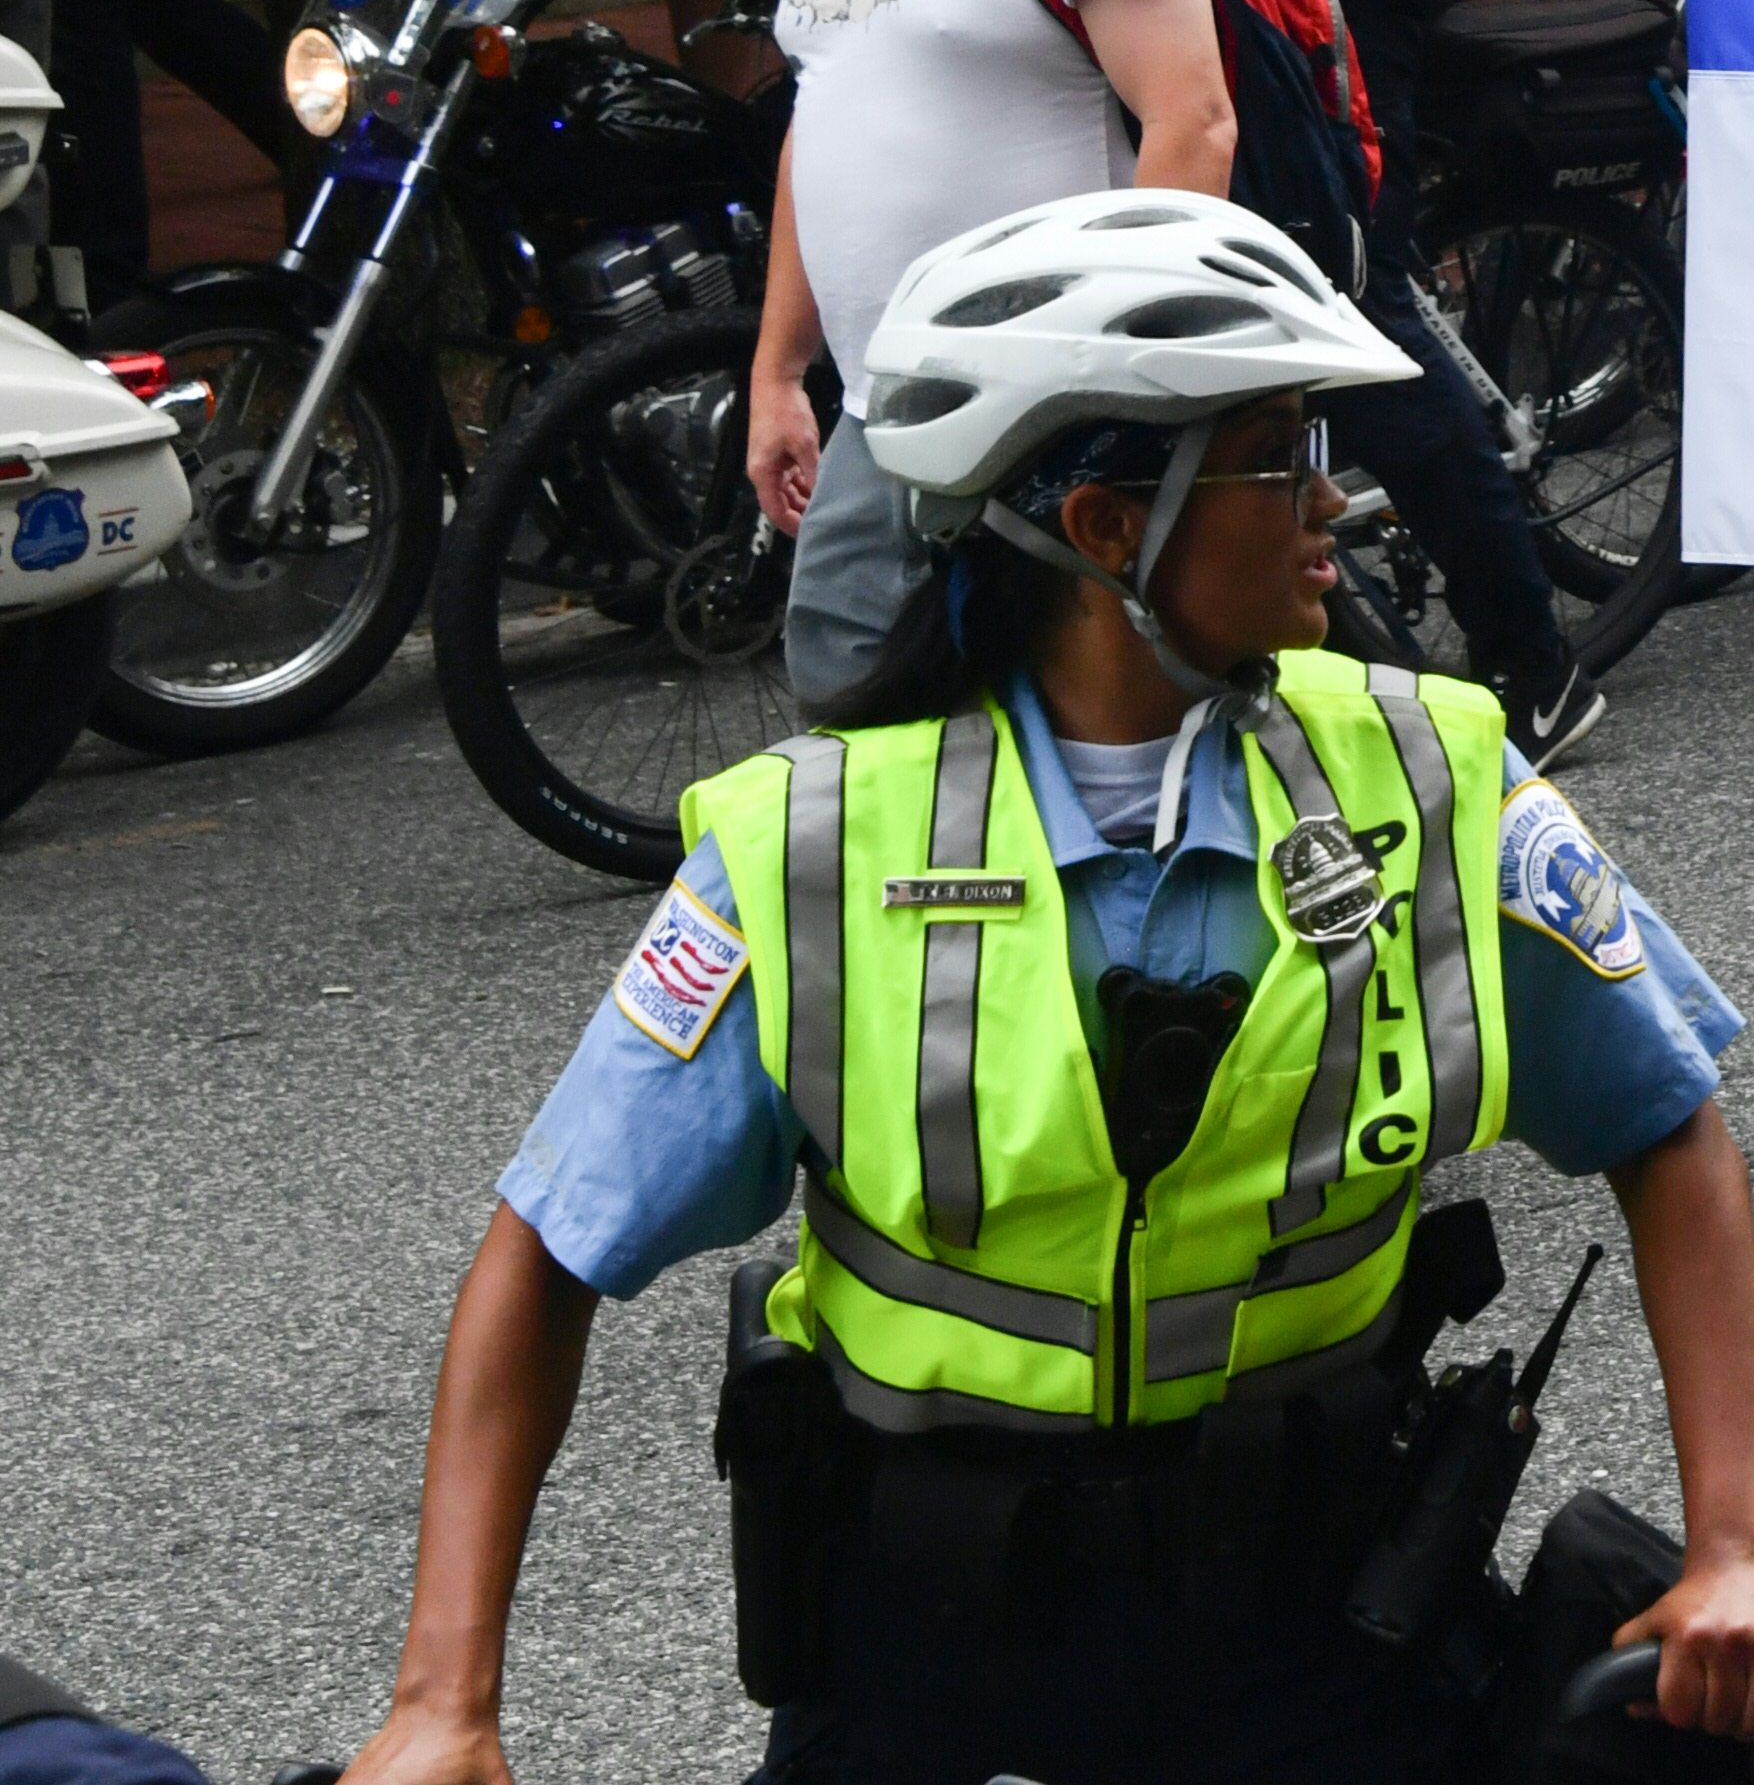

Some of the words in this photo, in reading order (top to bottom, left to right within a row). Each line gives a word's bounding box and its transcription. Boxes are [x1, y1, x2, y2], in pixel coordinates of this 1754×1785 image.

[598, 108, 709, 134] Rebel
[1553, 162, 1644, 190] POLICE
[102, 517, 136, 547] DC
[963, 884, 1014, 901] DIXON
[668, 897, 740, 965] WASHINGTON
[621, 973, 693, 1041] EXPERIENCE
[643, 976, 700, 1027] AMERICAN
